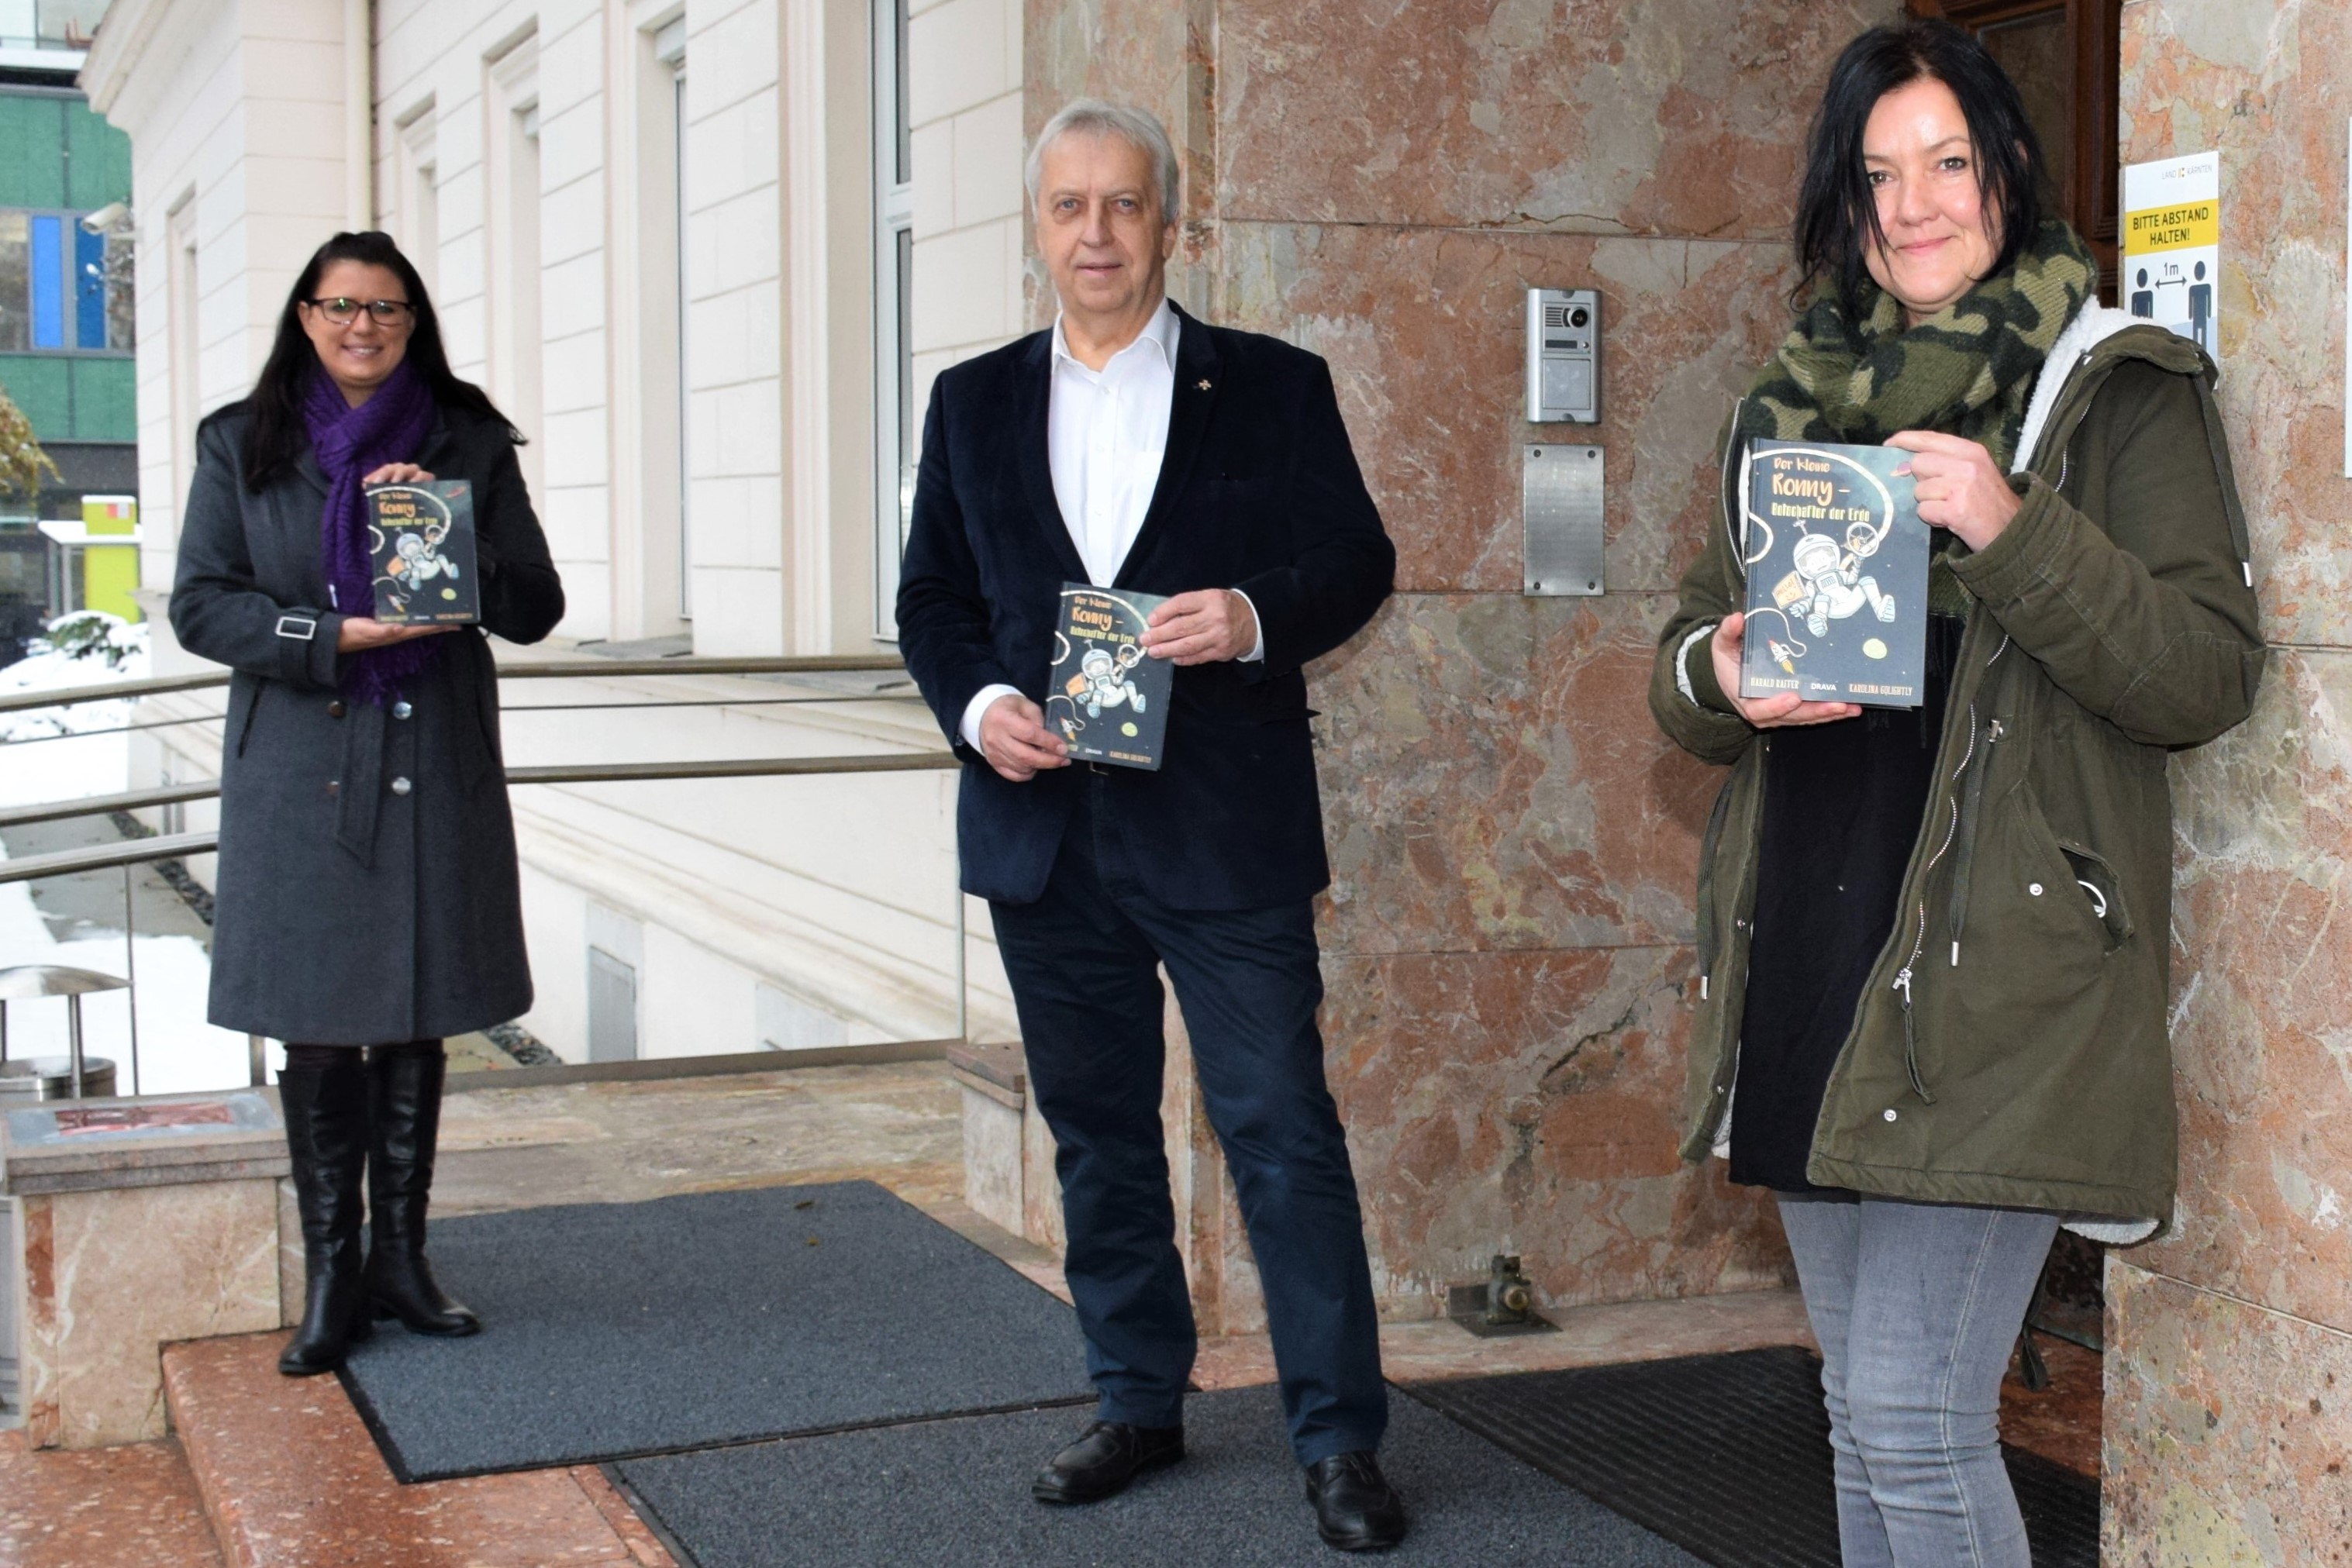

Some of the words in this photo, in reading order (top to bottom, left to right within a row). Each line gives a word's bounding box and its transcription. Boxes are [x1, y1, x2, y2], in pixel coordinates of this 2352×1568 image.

[2162, 170, 2177, 180] LAND
[2133, 214, 2160, 230] BITTE
[2161, 207, 2209, 226] ABSTAND
[2150, 228, 2190, 246] HALTEN!
[1774, 457, 1793, 470] Der
[1772, 473, 1833, 506] Ronny
[1829, 508, 1846, 520] der
[1848, 508, 1870, 522] Erde
[1750, 677, 1774, 688] HARALD
[1811, 683, 1836, 691] DRAVA
[1848, 684, 1878, 694] KAROLINA
